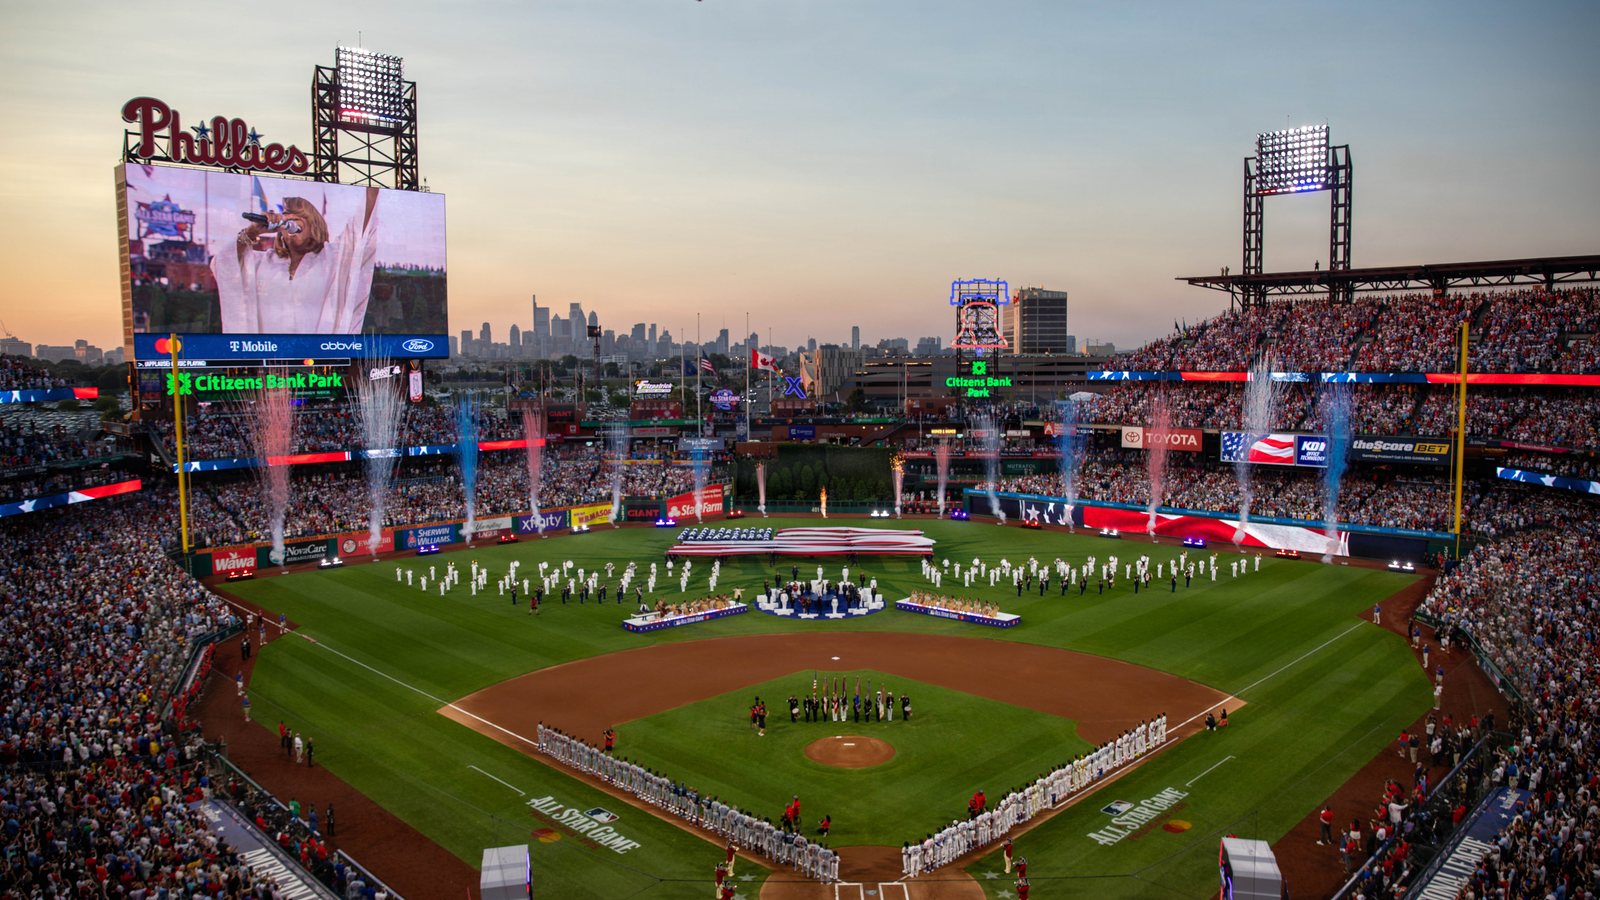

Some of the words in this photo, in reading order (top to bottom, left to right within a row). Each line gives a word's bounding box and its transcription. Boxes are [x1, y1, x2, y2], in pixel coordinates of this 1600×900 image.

[122, 97, 309, 174] Phillies
[242, 341, 278, 352] Mobile
[320, 341, 362, 350] abbvie
[407, 341, 428, 350] Ford
[195, 374, 263, 391] Citizens
[266, 372, 306, 389] Bank
[308, 372, 342, 388] Park
[946, 377, 986, 388] Citizens
[987, 376, 1012, 387] Bank
[967, 387, 990, 398] Park
[1145, 432, 1197, 446] TOYOTA
[1301, 441, 1326, 452] KDI
[1352, 439, 1413, 452] theScore
[1417, 444, 1447, 453] BET
[627, 509, 659, 517] GIANT
[681, 504, 703, 516] Stae
[702, 502, 722, 514] Farm
[418, 527, 450, 538] SHERWIN
[478, 529, 499, 539] LAGER
[417, 535, 450, 546] WILLIAMS
[286, 544, 327, 556] NovaCare
[215, 557, 255, 571] Wawa
[1086, 824, 1132, 846] ALL
[1111, 805, 1161, 831] STAR
[1139, 786, 1190, 818] GAME
[526, 795, 560, 815] ALL
[552, 808, 598, 834] STAR
[586, 825, 641, 855] GAME
[1441, 835, 1492, 875] LEAGUE
